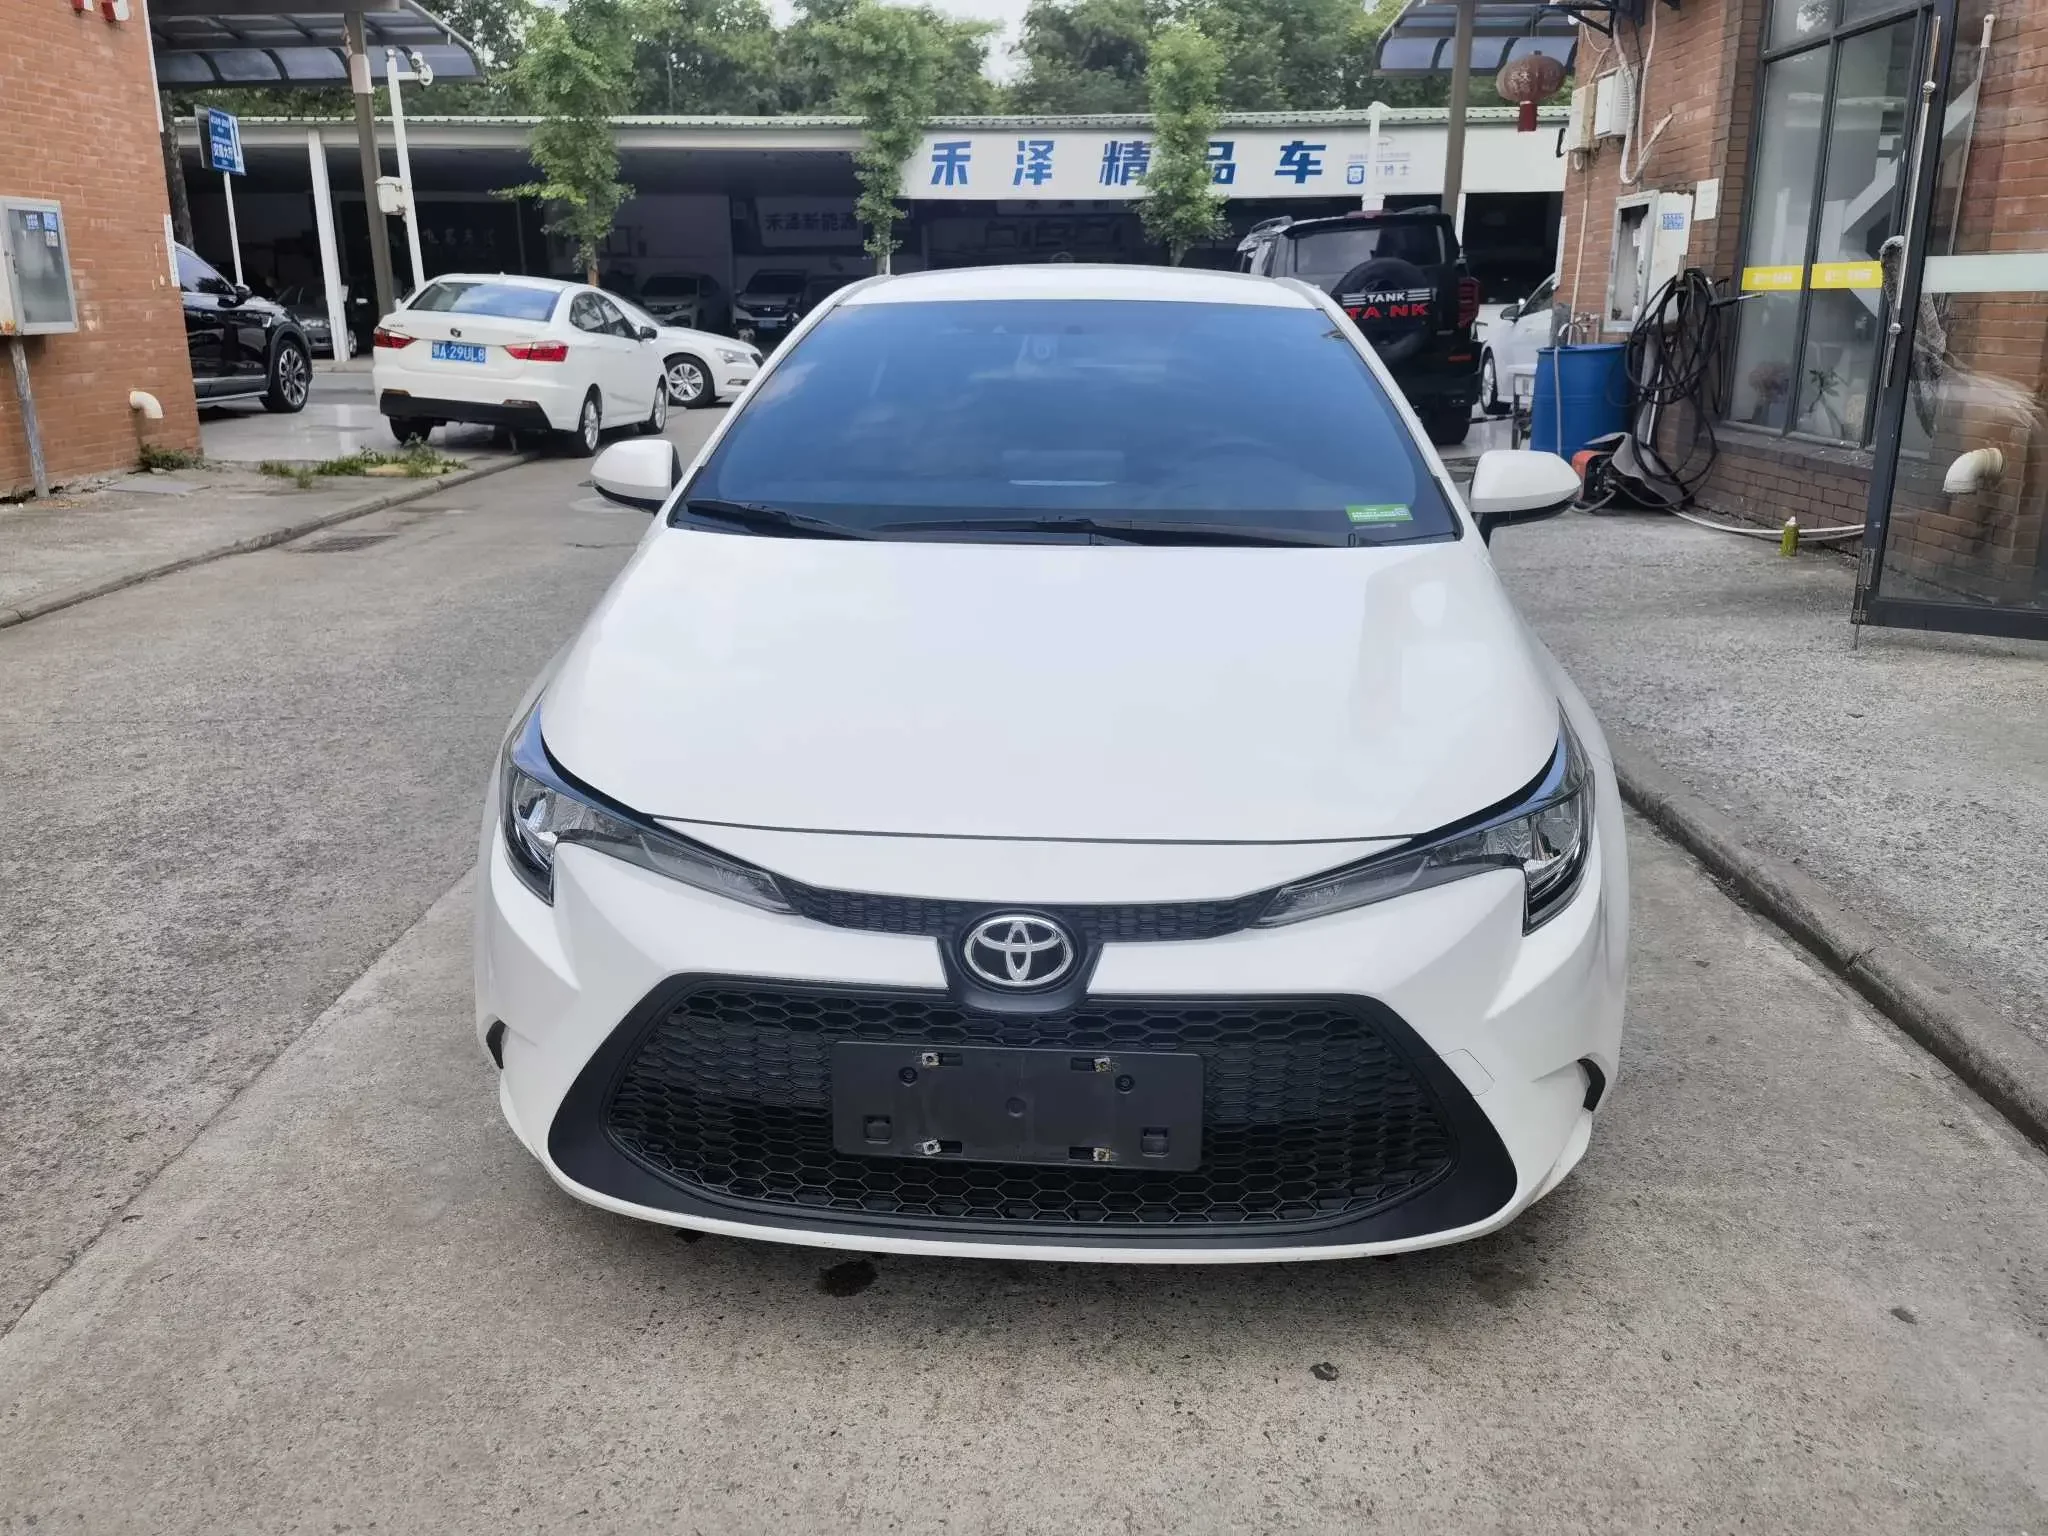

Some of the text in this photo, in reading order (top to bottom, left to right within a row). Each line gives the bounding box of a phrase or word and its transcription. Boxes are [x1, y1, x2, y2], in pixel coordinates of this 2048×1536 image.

[931, 140, 1327, 186] 禾泽精品车
[1367, 292, 1406, 304] TANK
